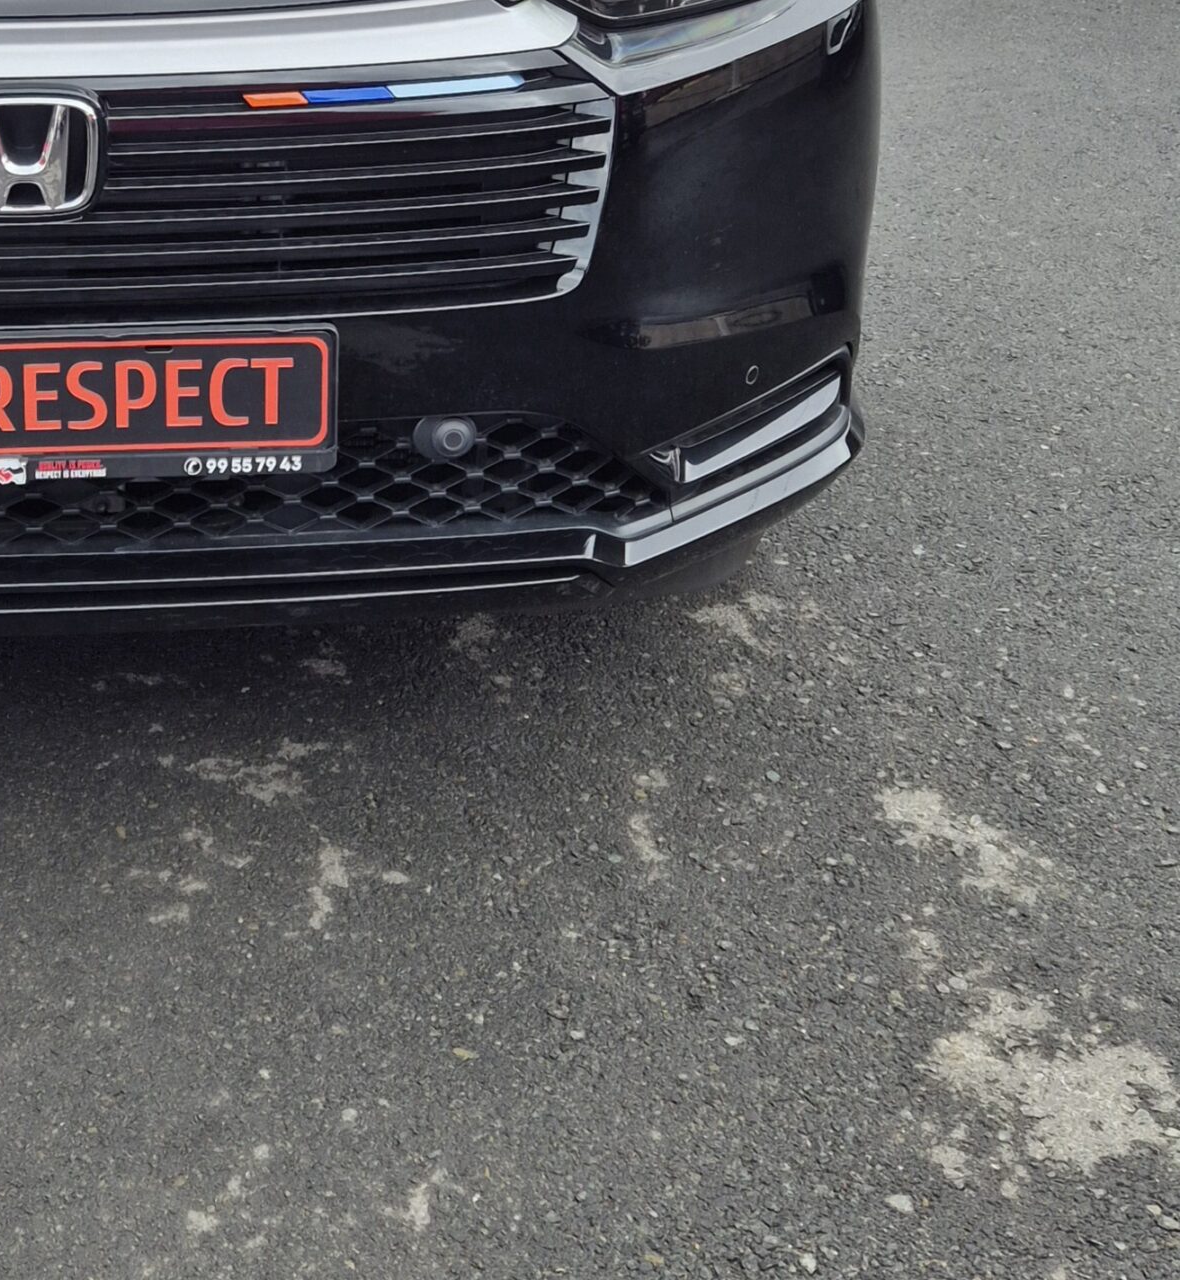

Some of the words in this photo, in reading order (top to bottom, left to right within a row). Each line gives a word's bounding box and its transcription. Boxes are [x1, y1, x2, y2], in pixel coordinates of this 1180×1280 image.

[205, 458, 228, 474] 99
[231, 457, 253, 473] 55
[255, 456, 277, 472] 79
[279, 455, 302, 471] 43
